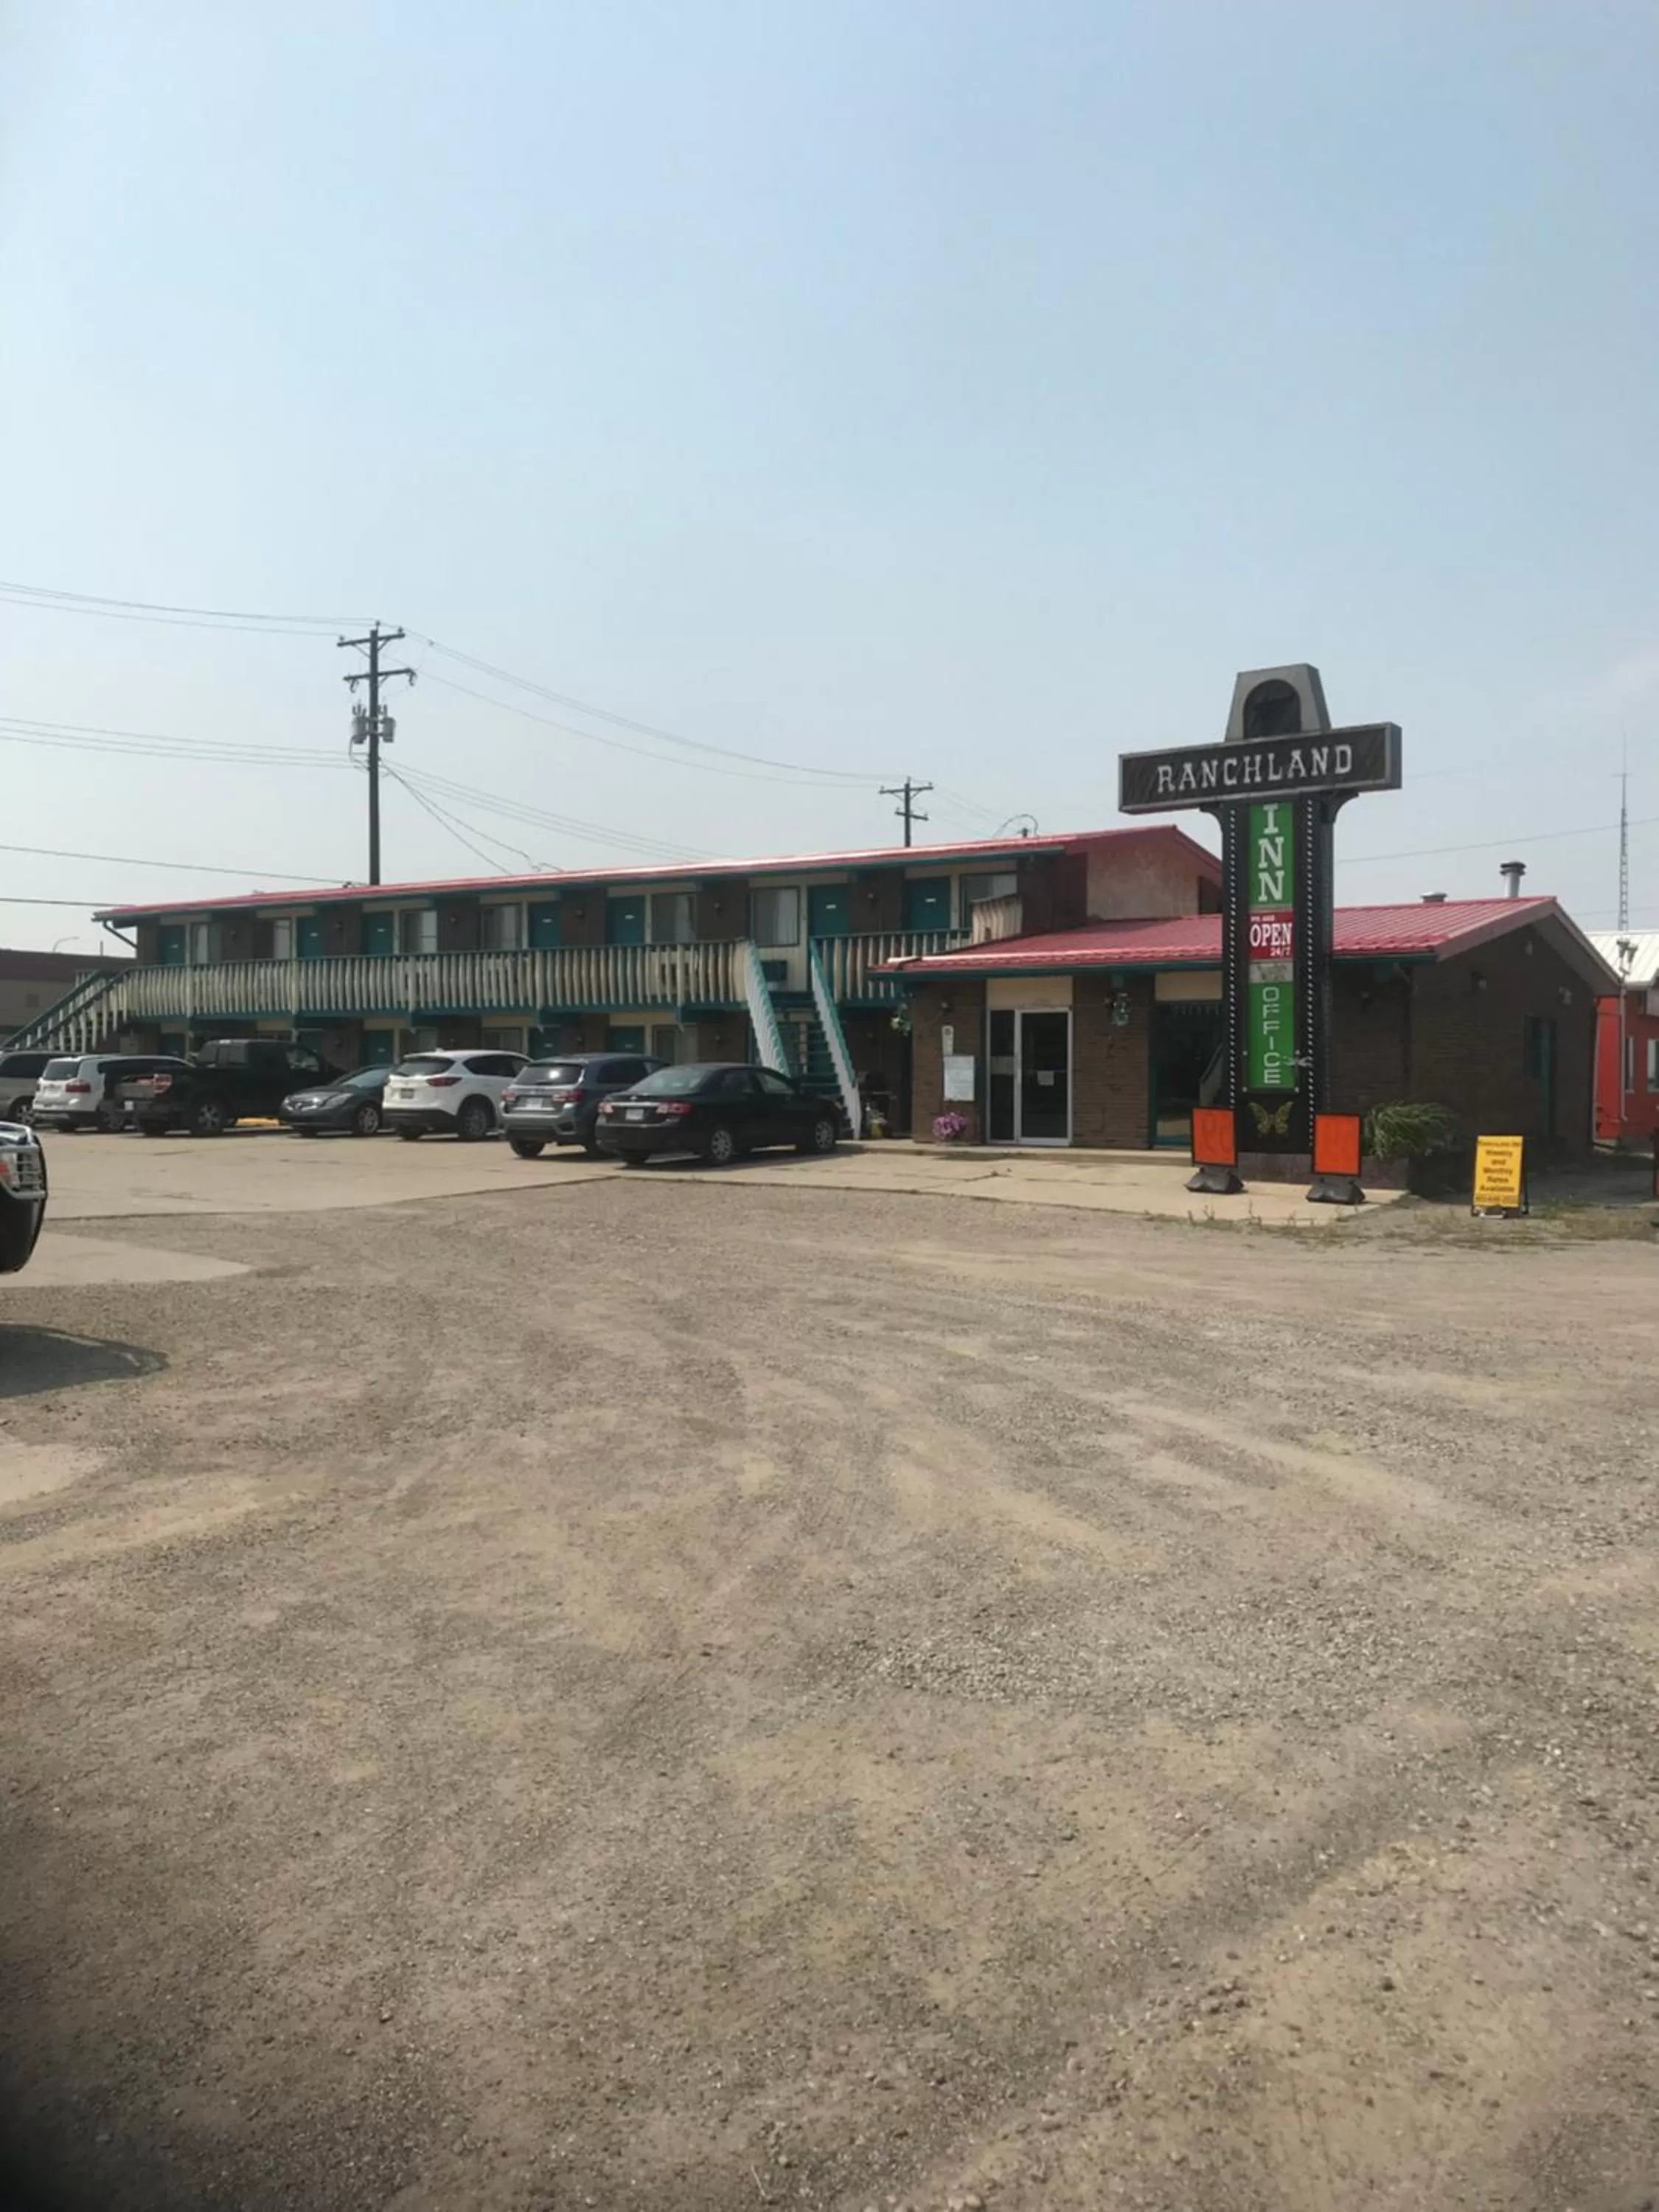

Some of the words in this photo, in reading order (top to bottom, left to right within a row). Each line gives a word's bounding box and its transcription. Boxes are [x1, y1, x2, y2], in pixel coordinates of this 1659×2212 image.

[1158, 744, 1352, 793] RANCHLAND
[1258, 803, 1284, 902] INN
[1250, 922, 1293, 947] OPEN
[1270, 947, 1291, 957] 24/7
[1262, 987, 1281, 1085] OFFICE
